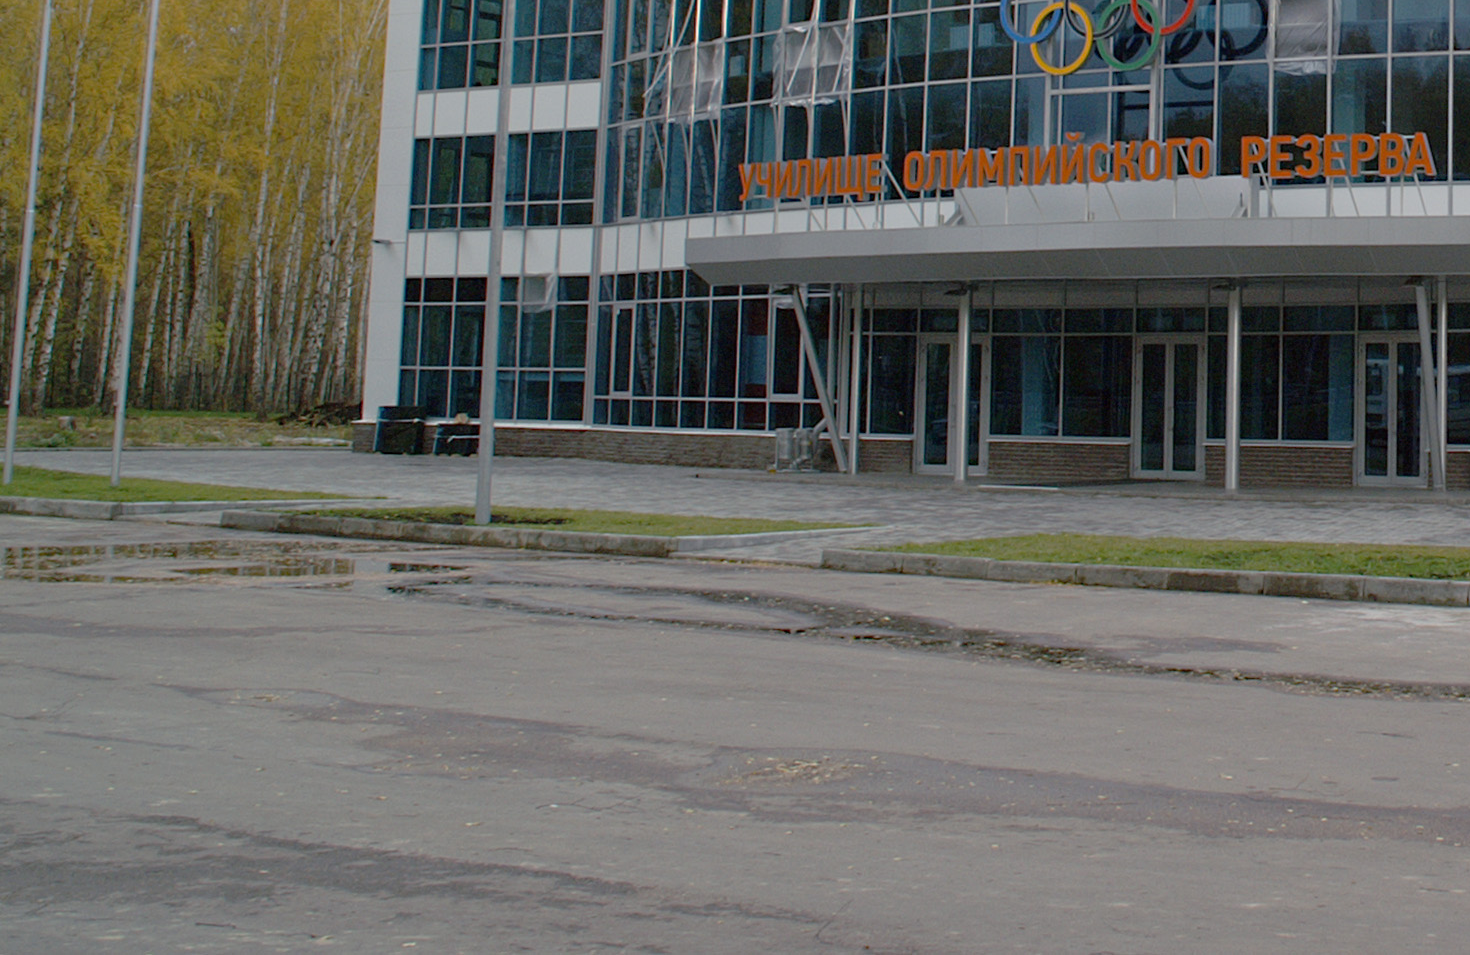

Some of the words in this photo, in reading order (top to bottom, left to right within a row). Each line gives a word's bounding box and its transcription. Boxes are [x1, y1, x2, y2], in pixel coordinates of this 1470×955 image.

[738, 153, 886, 202] УЧИЛИЩЕ
[903, 131, 1211, 191] ОЛИМПИЙСКОГО
[1241, 132, 1435, 178] РЕЗЕРВА
